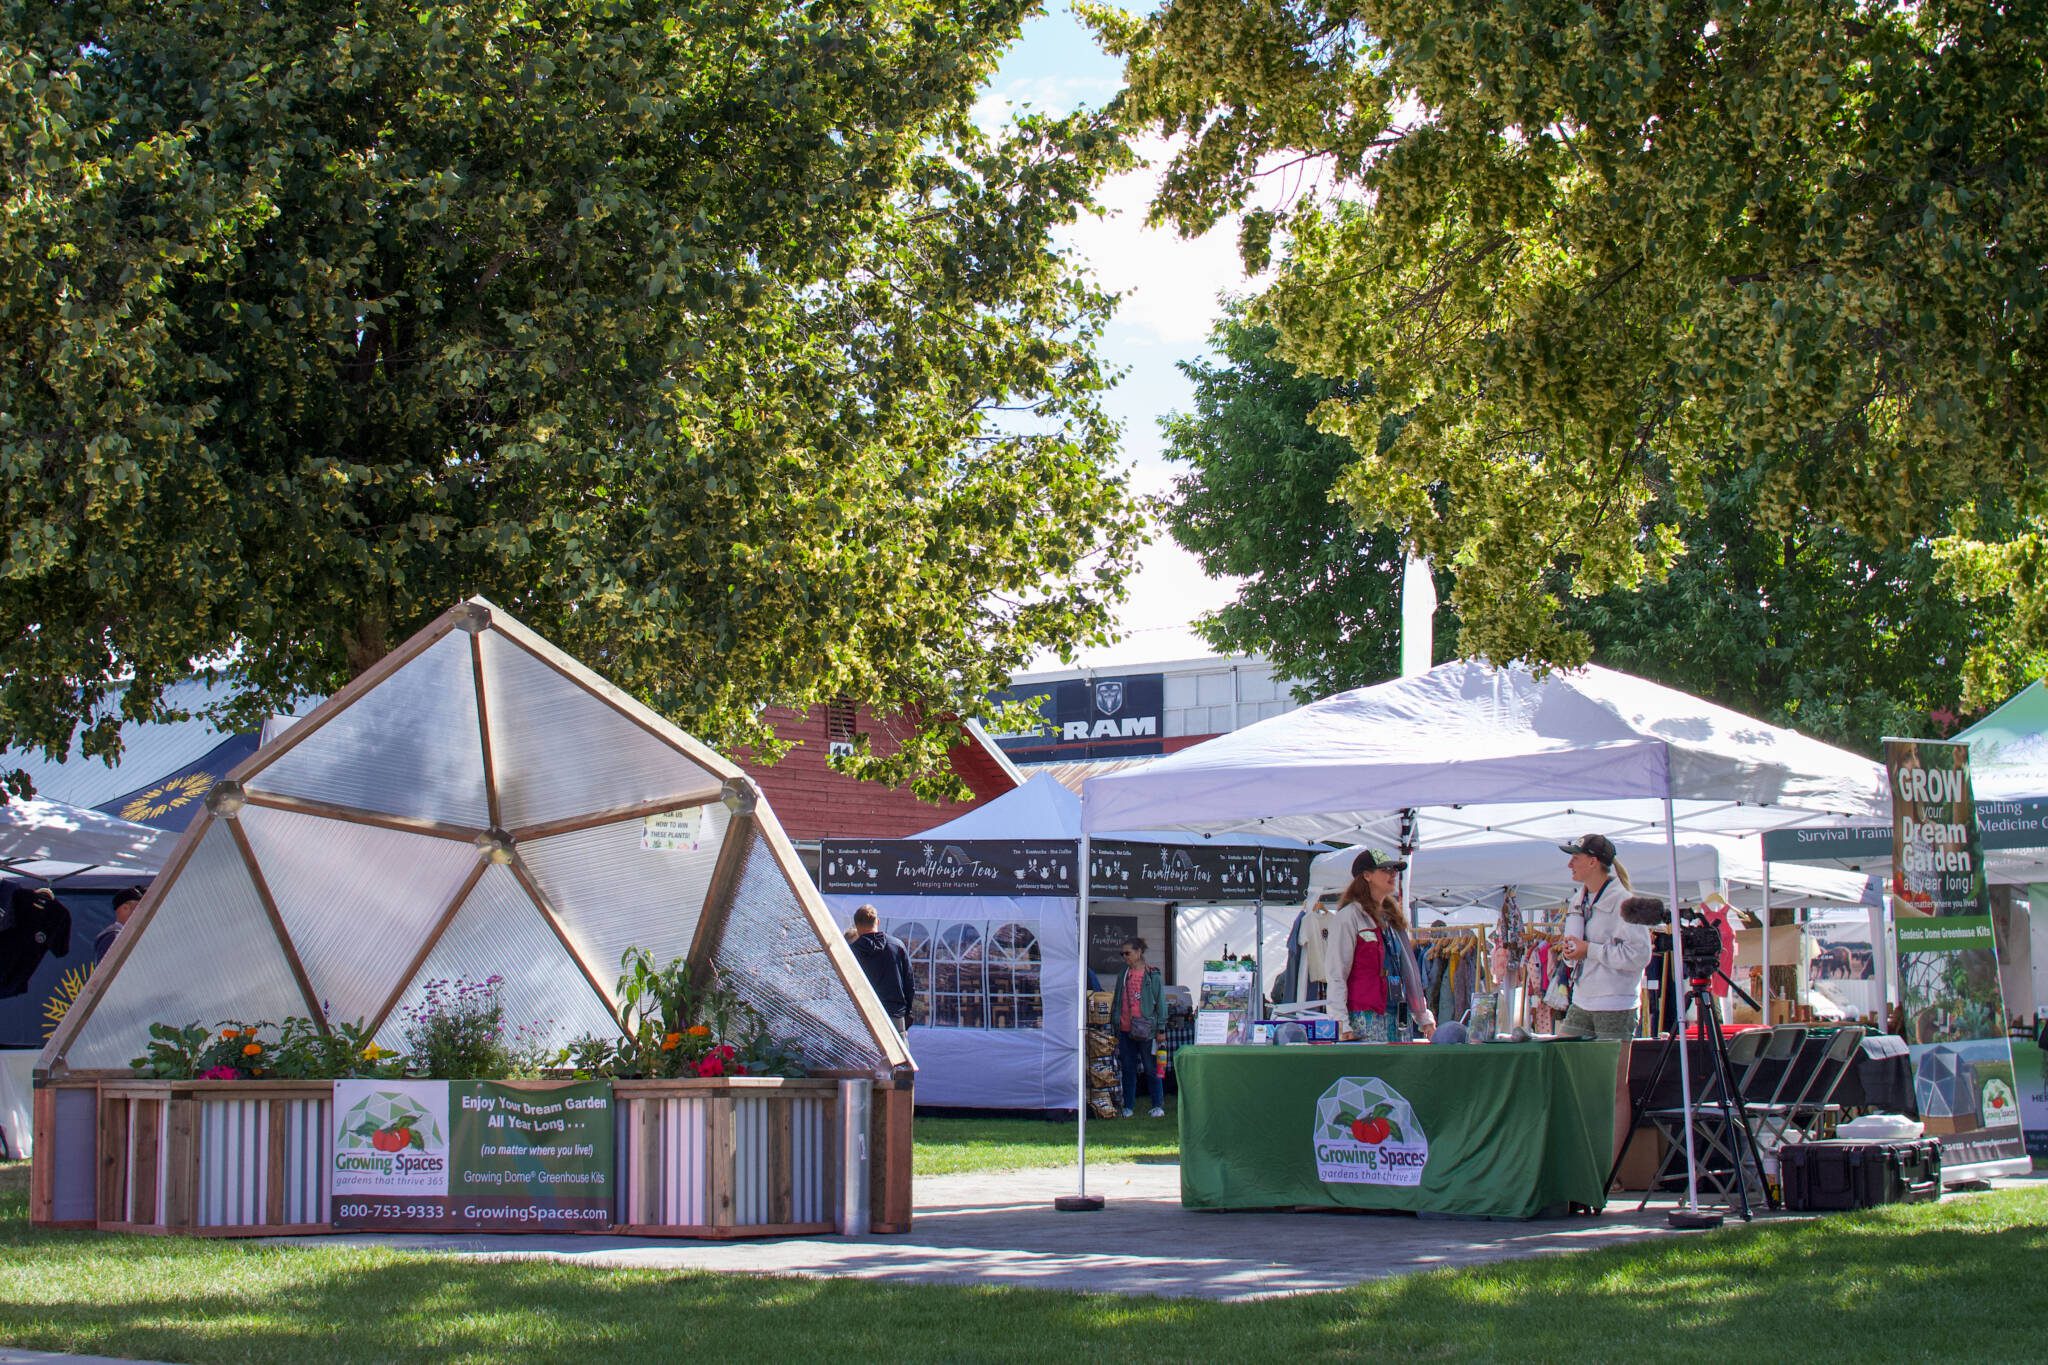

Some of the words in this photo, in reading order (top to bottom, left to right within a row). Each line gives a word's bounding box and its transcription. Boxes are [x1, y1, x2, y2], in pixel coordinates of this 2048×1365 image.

[1063, 716, 1157, 741] RAM
[1898, 767, 1962, 803] GROW
[1921, 806, 1943, 821] your
[1975, 800, 2022, 816] sulting
[1902, 816, 1967, 844] Dream
[1978, 818, 2038, 832] Medicine
[1797, 828, 1849, 842] Survival
[1902, 844, 1971, 872] Garden
[895, 860, 964, 879] FarmHouse
[970, 860, 1000, 879] Teas
[1192, 864, 1212, 882] Teas
[1916, 877, 1942, 894] year
[1946, 873, 1974, 894] long!
[1925, 928, 1941, 939] Dome
[1941, 927, 1975, 938] Greenhouse
[1976, 926, 1990, 937] Kits
[462, 1096, 495, 1112] Enjoy
[498, 1096, 521, 1112] Your
[523, 1102, 562, 1116] Dream
[565, 1096, 607, 1110] Garden
[488, 1114, 505, 1128] All
[508, 1115, 531, 1131] Year
[534, 1118, 565, 1132] Long
[480, 1143, 496, 1158] (no
[499, 1145, 527, 1156] matter
[529, 1145, 555, 1156] where
[557, 1147, 573, 1158] you
[574, 1143, 594, 1158] live!)
[1317, 1144, 1377, 1170] Growing
[1378, 1146, 1425, 1171] Spaces
[336, 1152, 393, 1175] Growing
[395, 1153, 443, 1175] Spaces
[336, 1176, 373, 1187] gardens
[375, 1175, 395, 1185] that
[397, 1175, 425, 1185] thrive
[427, 1176, 445, 1186] 365
[464, 1170, 502, 1185] Growing
[538, 1170, 590, 1183] Greenhouse
[591, 1171, 605, 1184] Kits
[1321, 1170, 1359, 1180] gardens
[1361, 1170, 1380, 1180] that
[1382, 1171, 1409, 1182] thrive
[340, 1204, 444, 1218] 800-753-9333
[464, 1205, 608, 1222] GrowingSpaces.com
